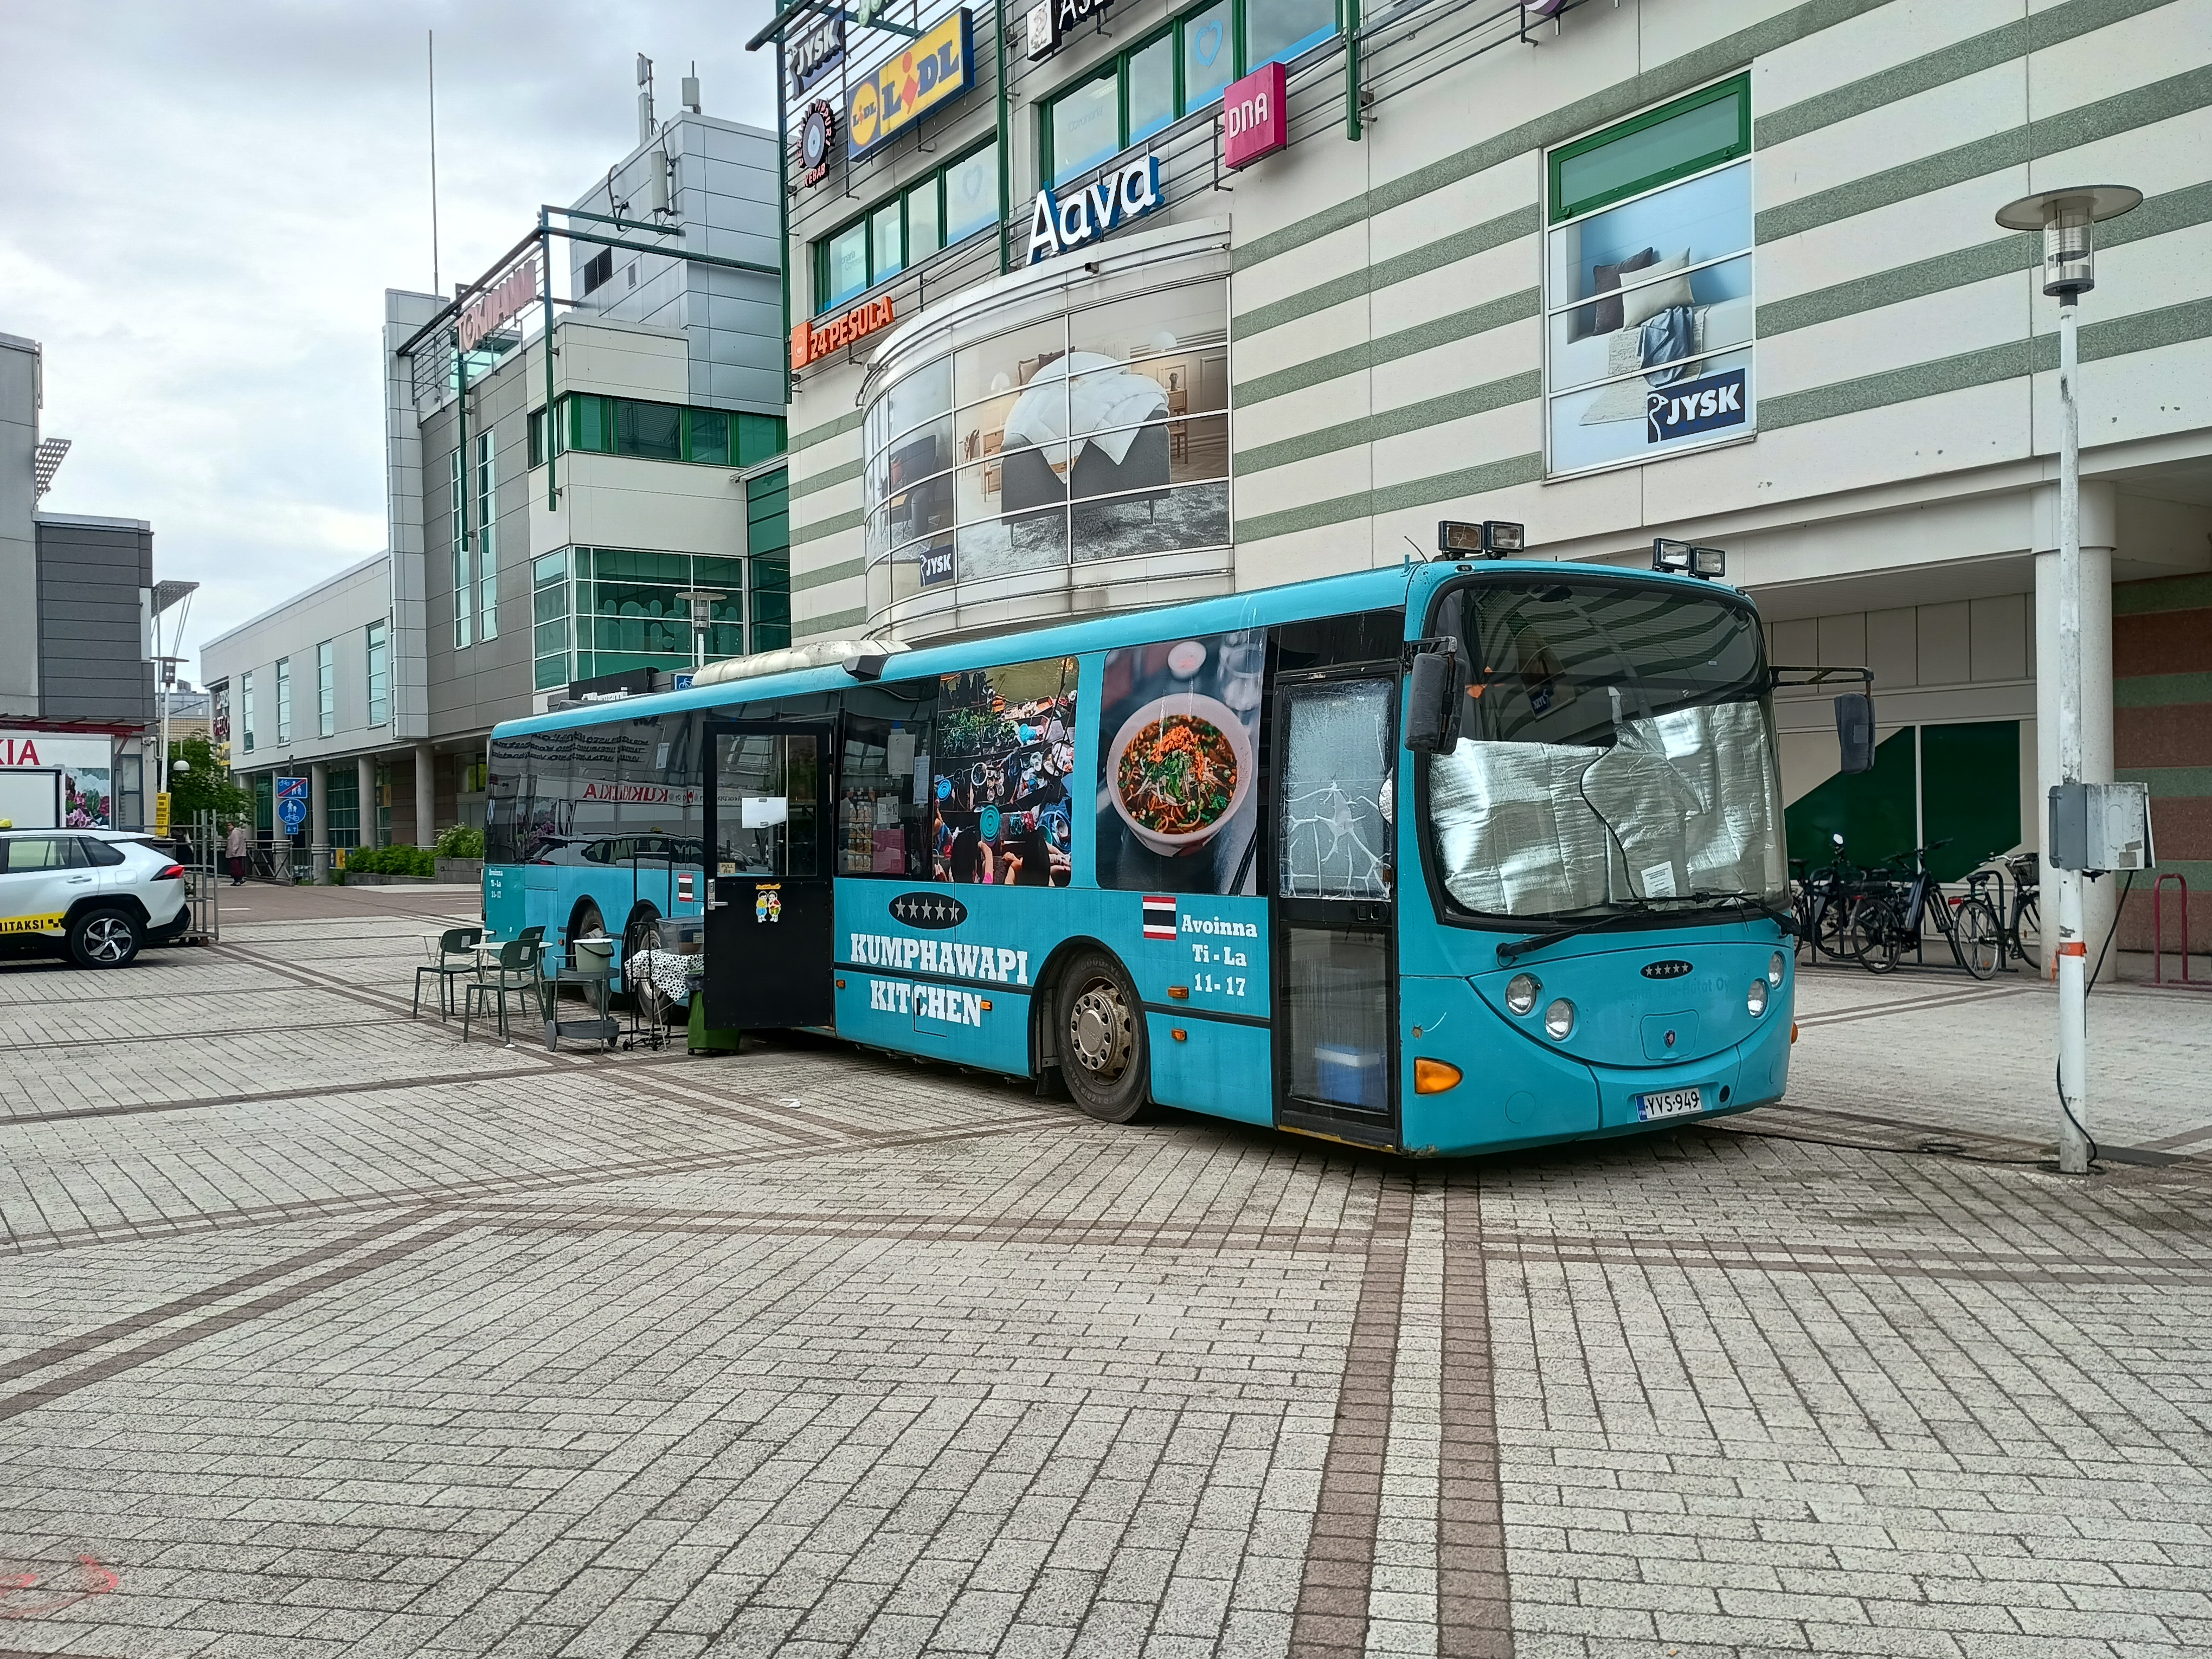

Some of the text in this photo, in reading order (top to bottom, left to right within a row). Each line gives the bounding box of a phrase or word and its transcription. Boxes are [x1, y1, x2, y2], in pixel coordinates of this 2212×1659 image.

[797, 18, 841, 75] JYSK
[1229, 92, 1268, 139] DNA
[805, 163, 826, 187] KEBAB
[1026, 155, 1160, 266] Aava
[810, 296, 892, 360] 24 PESULA
[1666, 383, 1741, 425] JYSK
[926, 553, 952, 576] JYSK
[1181, 914, 1258, 937] Avoinna
[851, 933, 1028, 985] KUMPHAWAPI
[1192, 944, 1210, 963] Ti
[1224, 947, 1247, 967] La
[870, 980, 982, 1027] KITCHEN
[1647, 1091, 1699, 1115] YVS-949
